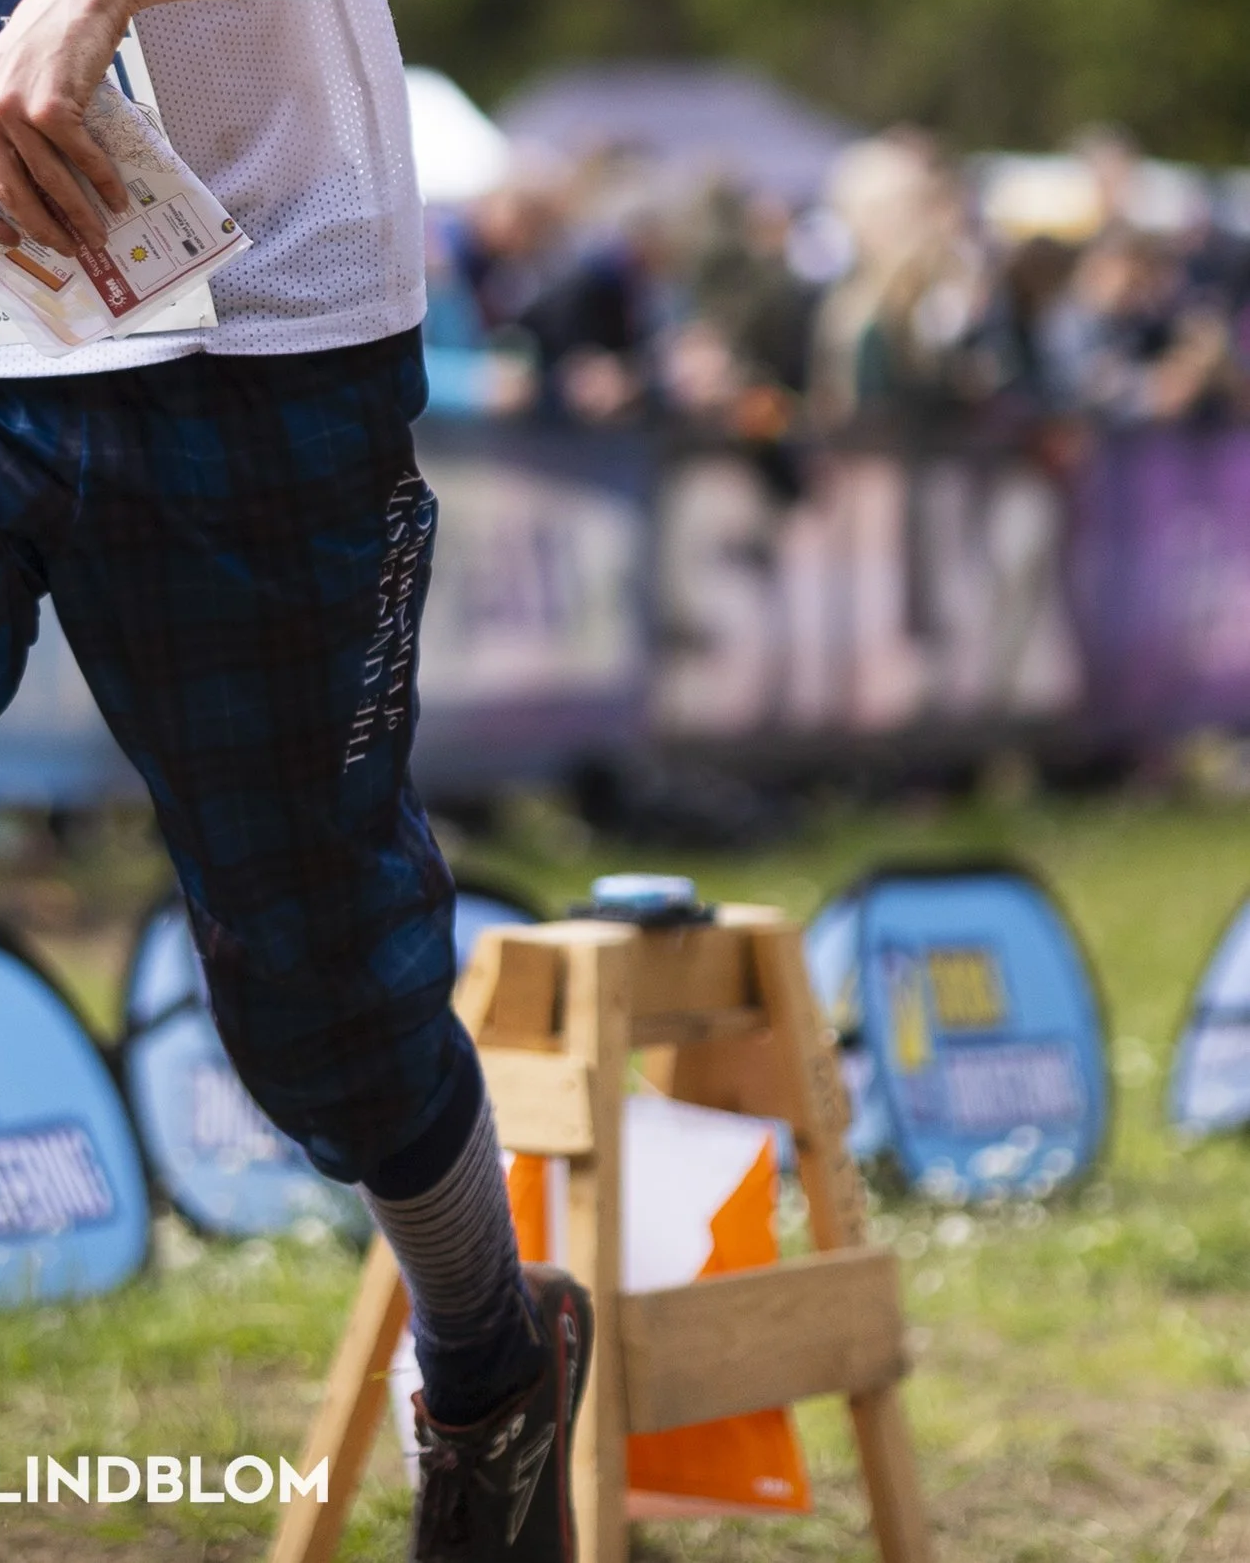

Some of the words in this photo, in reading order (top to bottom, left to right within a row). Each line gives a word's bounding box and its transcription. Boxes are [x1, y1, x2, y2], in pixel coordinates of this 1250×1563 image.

[105, 277, 124, 299] SM
[343, 693, 380, 774] THE
[363, 470, 422, 687] UNIVERSITY
[383, 703, 405, 731] of
